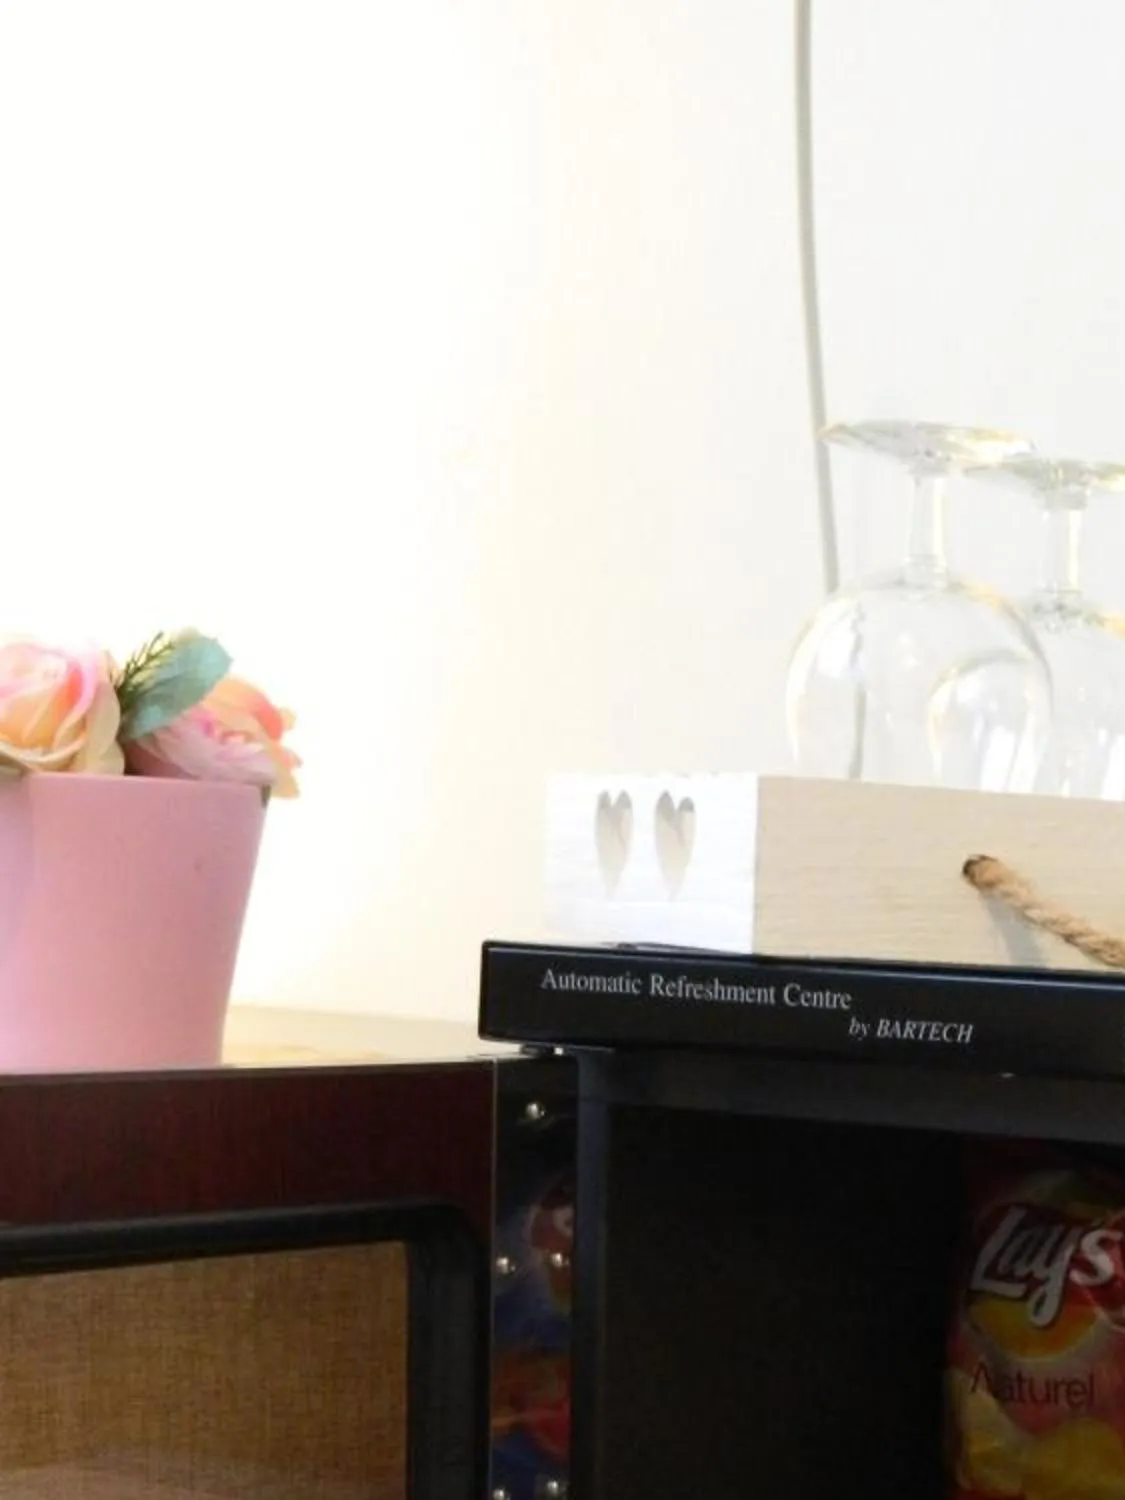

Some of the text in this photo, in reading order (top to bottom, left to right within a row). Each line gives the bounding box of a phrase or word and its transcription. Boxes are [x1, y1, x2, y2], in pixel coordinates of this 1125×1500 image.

[539, 967, 853, 1011] Automatic Refreshment Centre
[849, 1016, 974, 1045] by BARTECH
[970, 1361, 1096, 1410] Naturel
